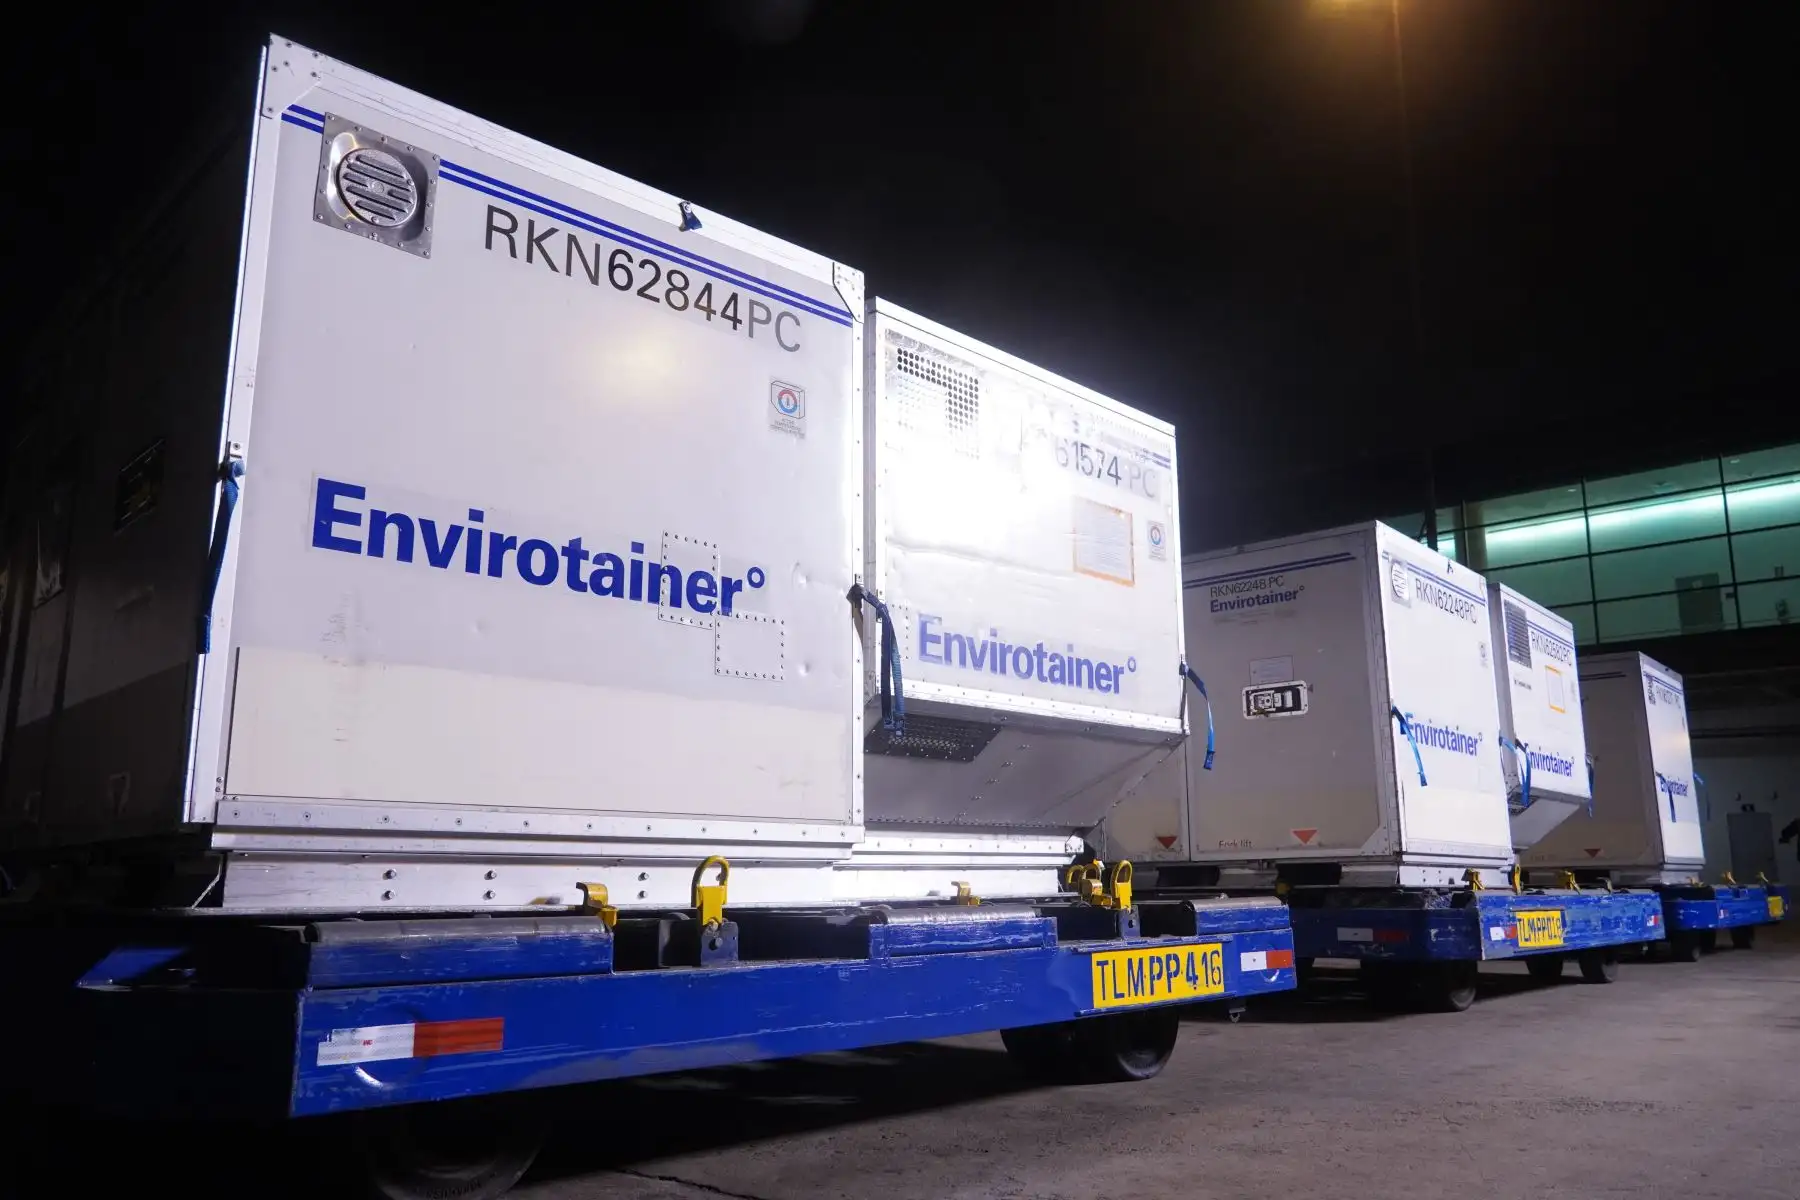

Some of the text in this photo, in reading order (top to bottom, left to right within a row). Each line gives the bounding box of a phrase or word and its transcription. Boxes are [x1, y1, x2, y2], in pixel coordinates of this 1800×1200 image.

[485, 203, 801, 353] RKN62844PC
[1129, 462, 1156, 498] PC
[1096, 949, 1222, 1001] TLMPP416
